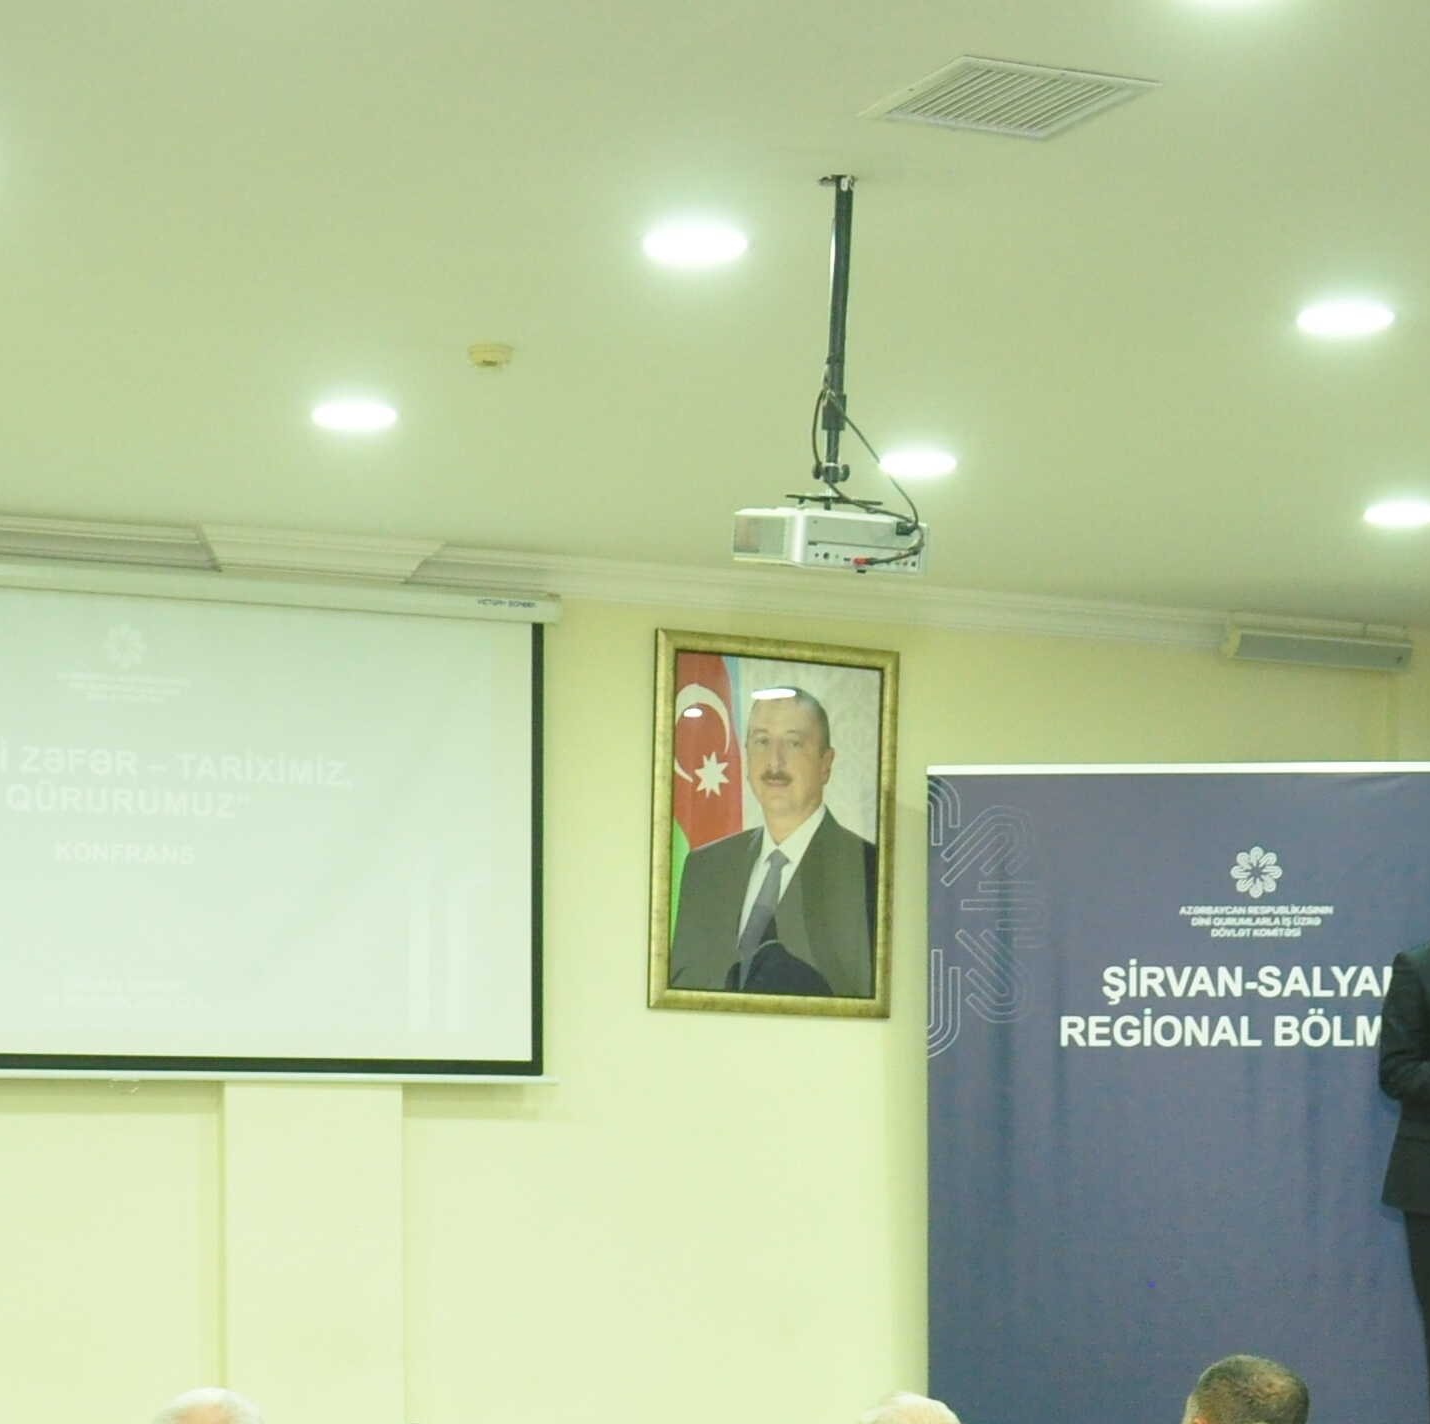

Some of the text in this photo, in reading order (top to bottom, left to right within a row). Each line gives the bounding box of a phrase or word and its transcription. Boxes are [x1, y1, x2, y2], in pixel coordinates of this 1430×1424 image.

[20, 744, 139, 777] ZƏFƏR
[176, 747, 354, 791] TARİXİMİZ,
[1060, 1007, 1383, 1047] REGİONAL BÖLM
